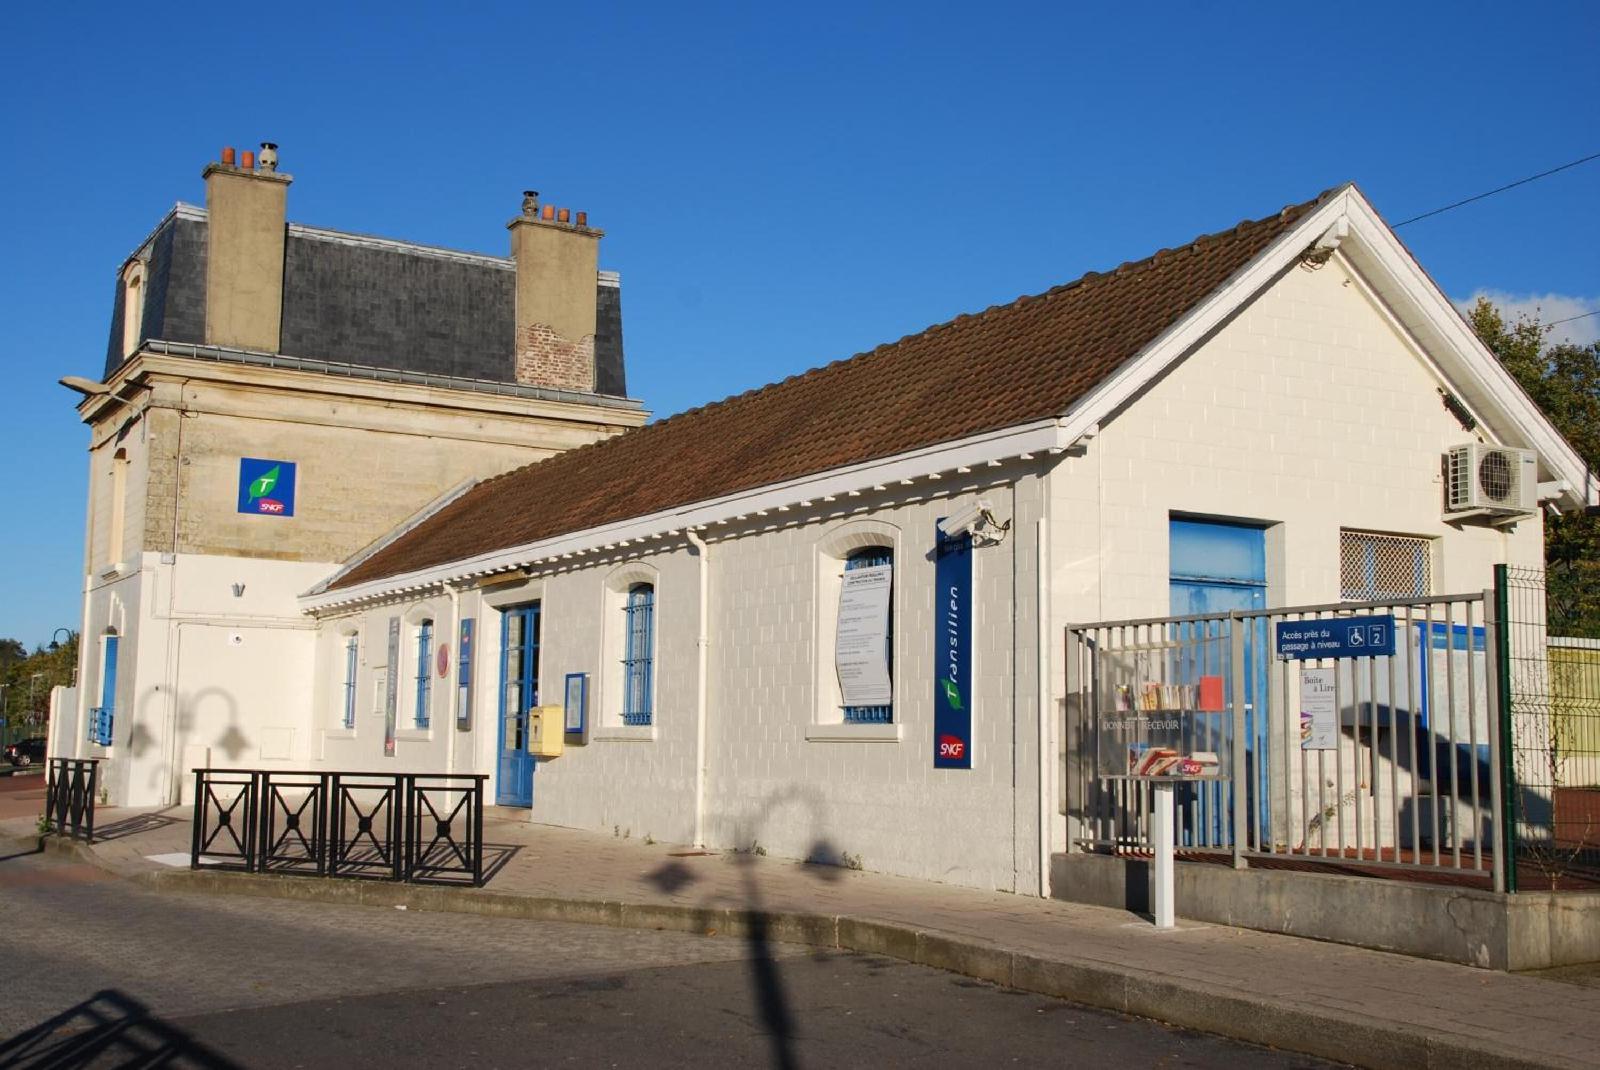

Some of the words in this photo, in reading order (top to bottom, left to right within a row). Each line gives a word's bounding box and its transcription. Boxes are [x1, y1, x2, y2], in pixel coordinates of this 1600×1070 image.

[261, 478, 274, 492] T
[260, 503, 283, 511] SNCF
[1282, 631, 1302, 640] Accès
[1304, 630, 1319, 640] près
[1321, 628, 1329, 637] du
[1373, 633, 1380, 644] 2
[947, 586, 958, 699] Transilien
[1281, 643, 1309, 652] passage
[1311, 641, 1316, 649] à
[1317, 641, 1341, 649] niveau
[1143, 720, 1179, 730] RECEVOIR
[939, 743, 963, 756] SNCF
